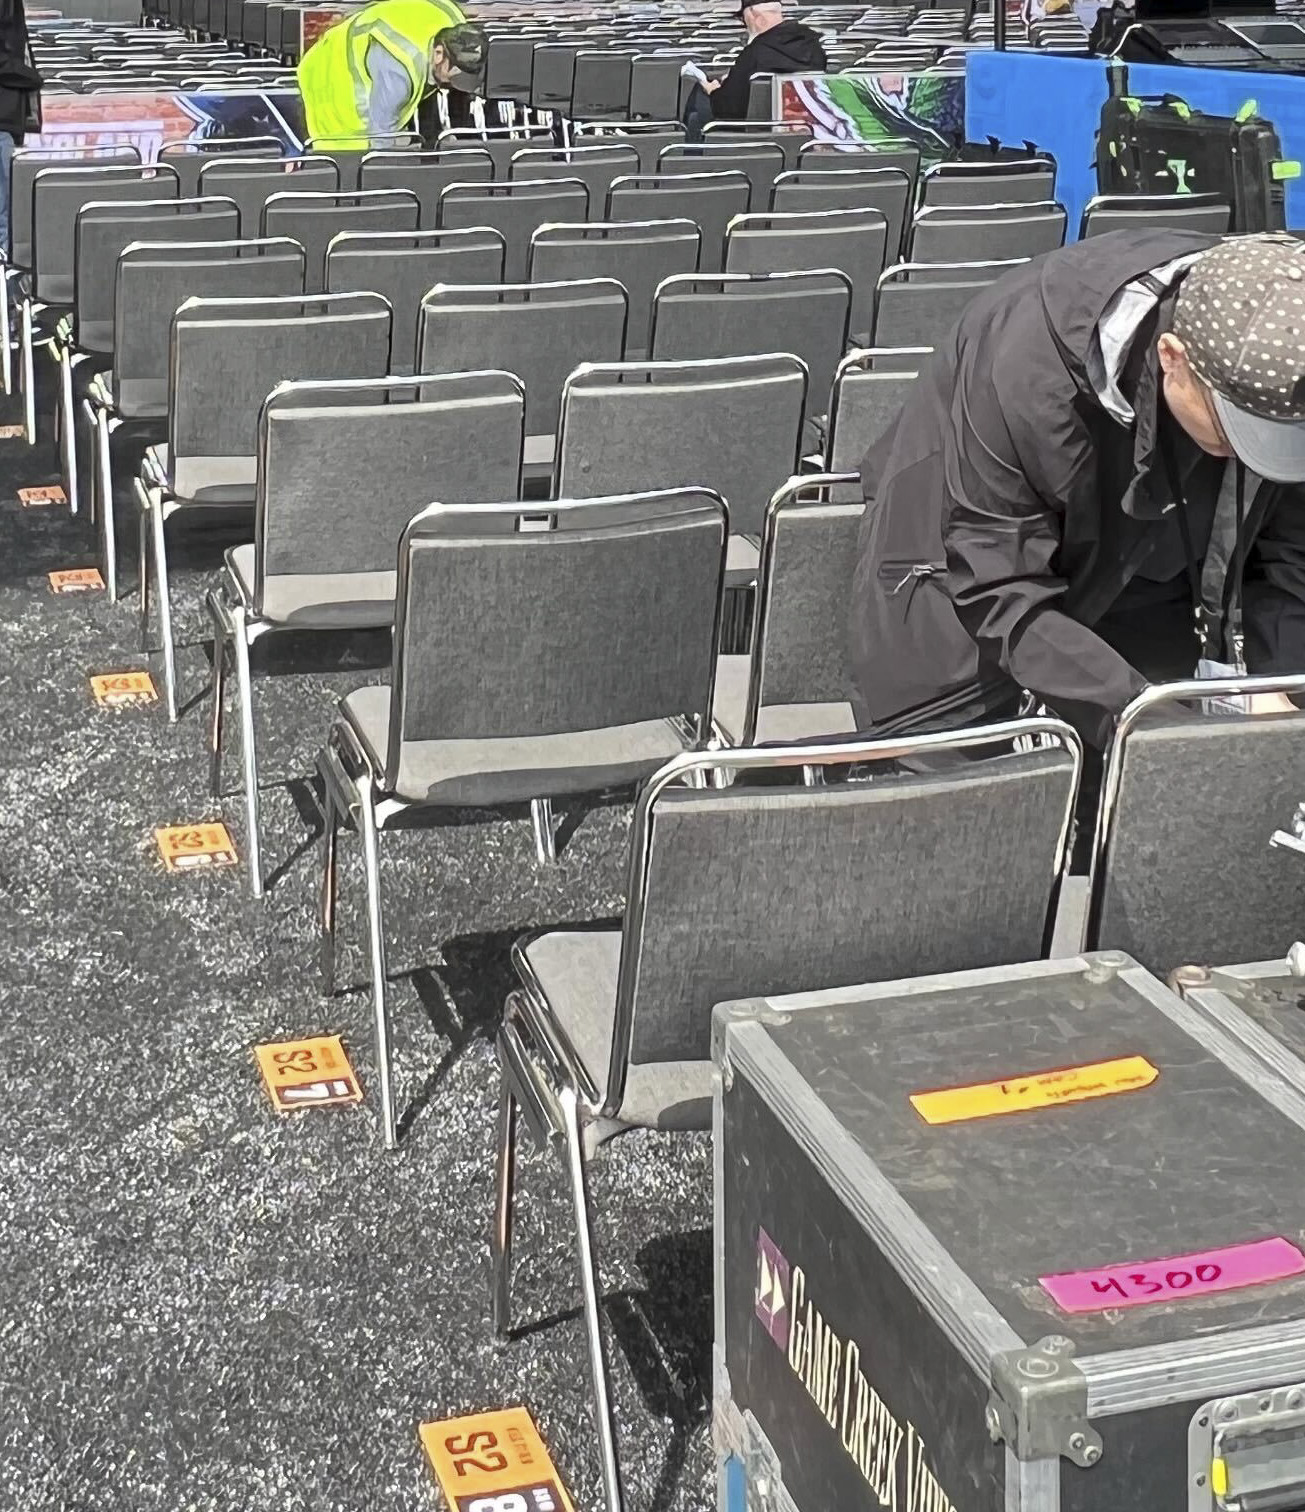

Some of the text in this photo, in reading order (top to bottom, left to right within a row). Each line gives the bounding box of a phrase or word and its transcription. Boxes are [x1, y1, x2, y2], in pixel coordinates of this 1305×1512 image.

[1090, 1263, 1223, 1300] 4300
[788, 1264, 904, 1512] GAME CREEK
[444, 1430, 509, 1477] S2
